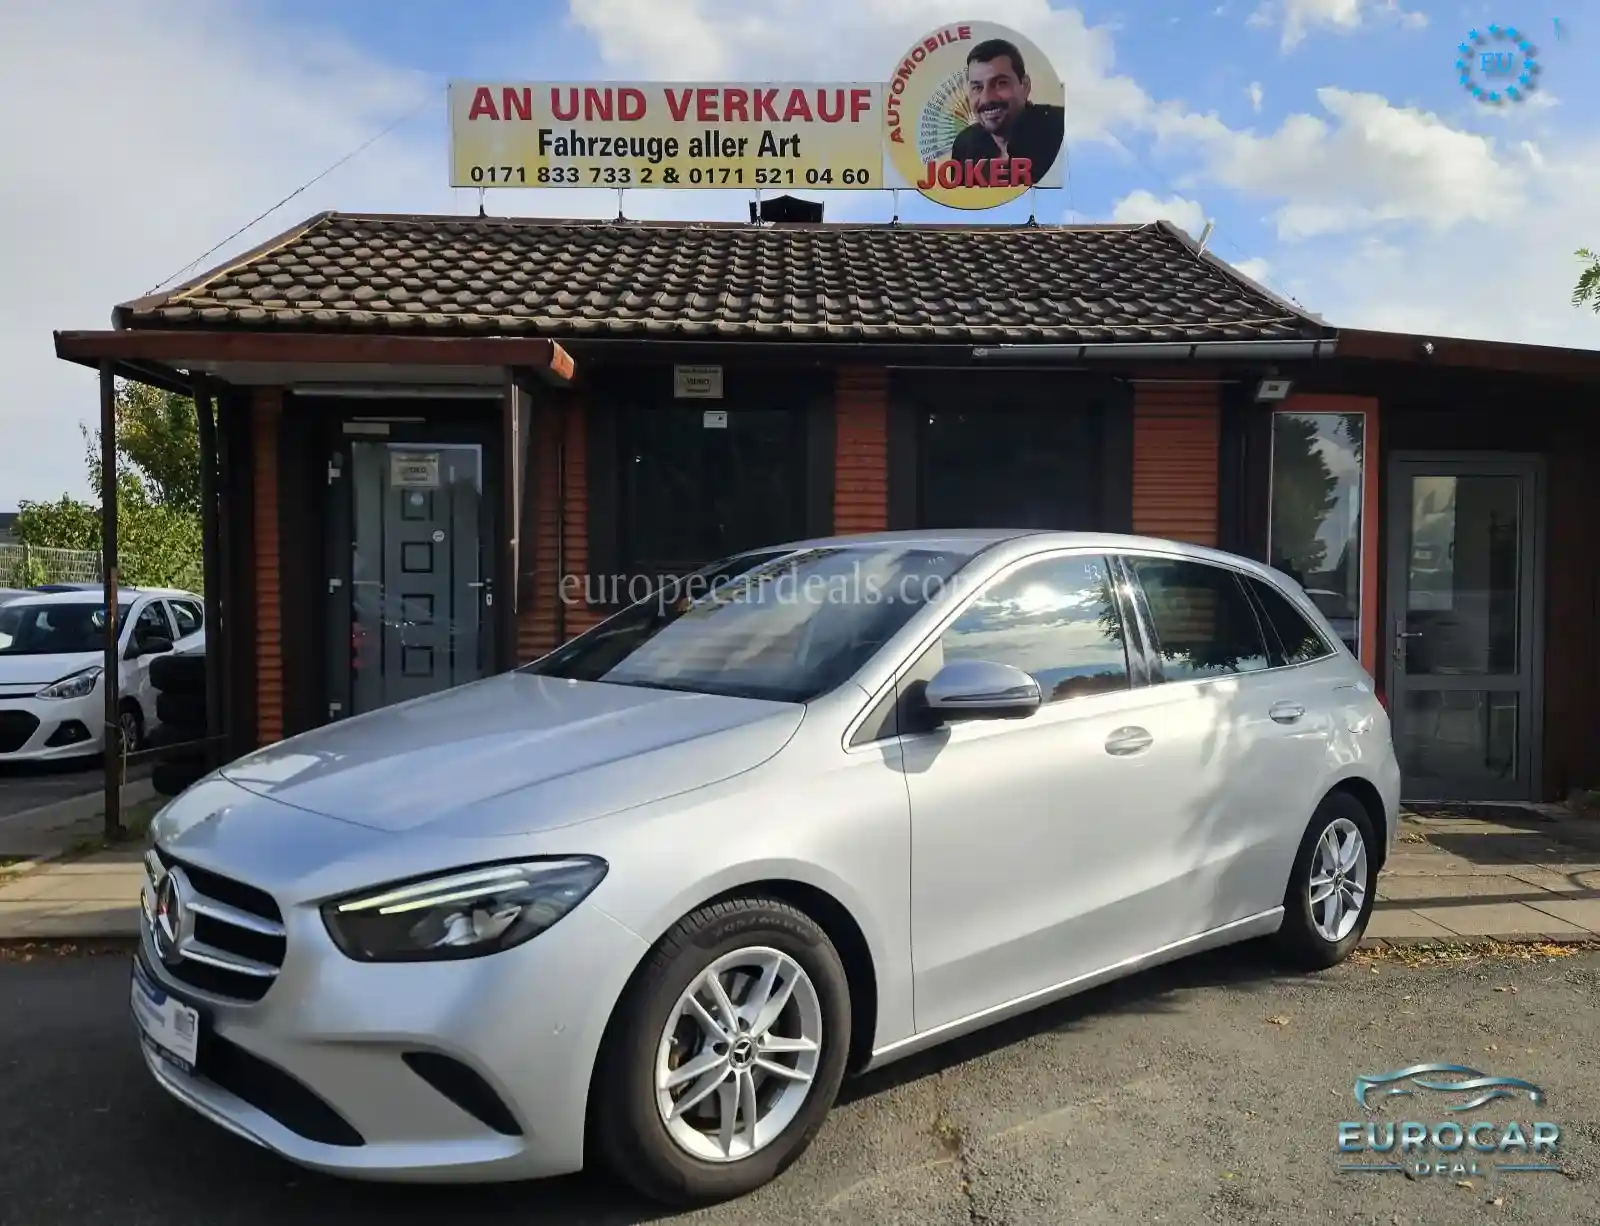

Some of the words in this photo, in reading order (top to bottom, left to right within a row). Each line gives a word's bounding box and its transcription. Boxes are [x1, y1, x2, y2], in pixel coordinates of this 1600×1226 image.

[887, 25, 973, 143] AUTOMOBILE
[469, 86, 533, 121] AN
[550, 87, 648, 122] UND
[664, 88, 871, 123] VERKAUF
[538, 128, 679, 164] Fahrzeuge
[688, 129, 749, 158] aller
[757, 129, 801, 158] Art
[470, 166, 526, 183] 0171
[537, 166, 580, 183] 833
[588, 167, 631, 184] 733
[640, 167, 653, 184] 2
[662, 167, 680, 184] &
[688, 167, 744, 184] 0171
[755, 167, 794, 184] 521
[805, 168, 834, 184] 04
[842, 168, 870, 185] 60
[916, 157, 1034, 190] JOKER
